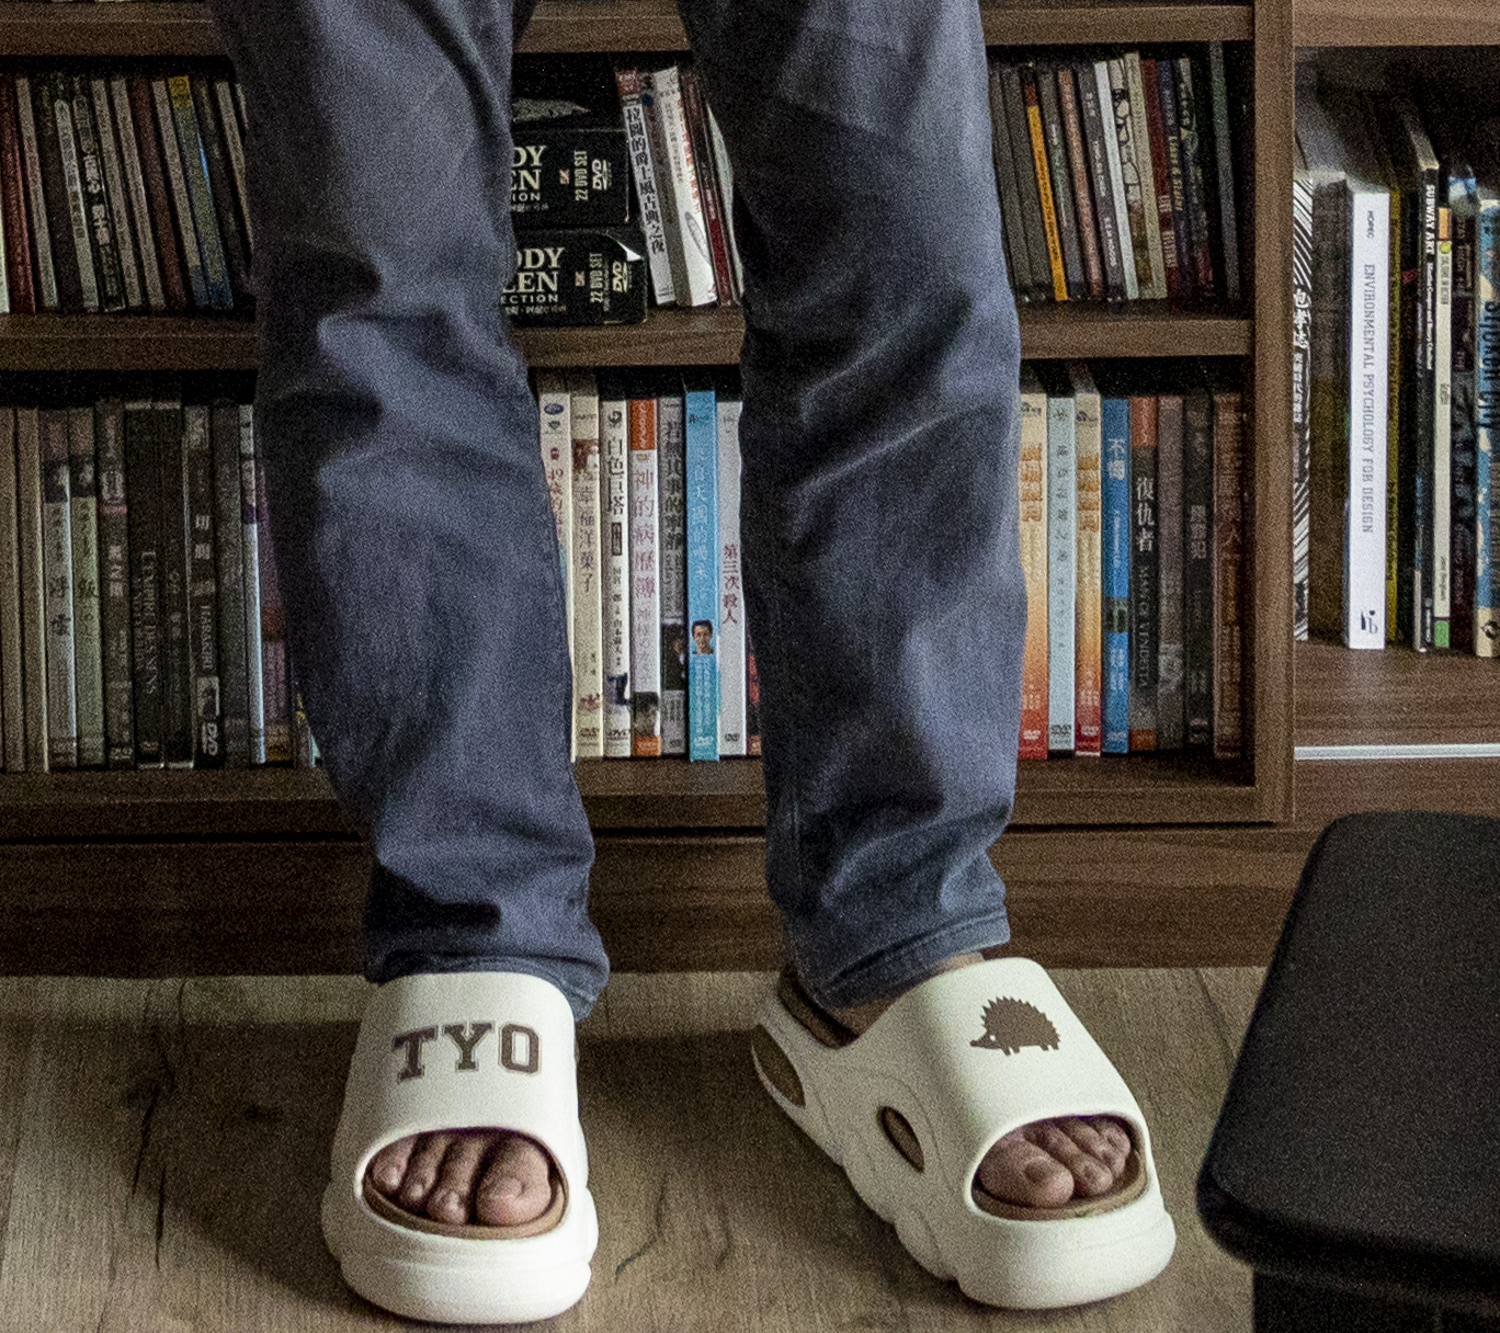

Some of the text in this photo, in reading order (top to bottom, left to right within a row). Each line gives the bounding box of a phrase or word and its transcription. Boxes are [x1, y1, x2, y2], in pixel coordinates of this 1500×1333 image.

[574, 150, 588, 202] 22 DVD SET
[589, 253, 602, 303] 22 DVD SET
[1362, 264, 1376, 534] ENVIRONMENTAL PSYCHOLOGY FOR DESIGN
[1135, 476, 1155, 553] 復仇者
[392, 1022, 542, 1083] TYO
